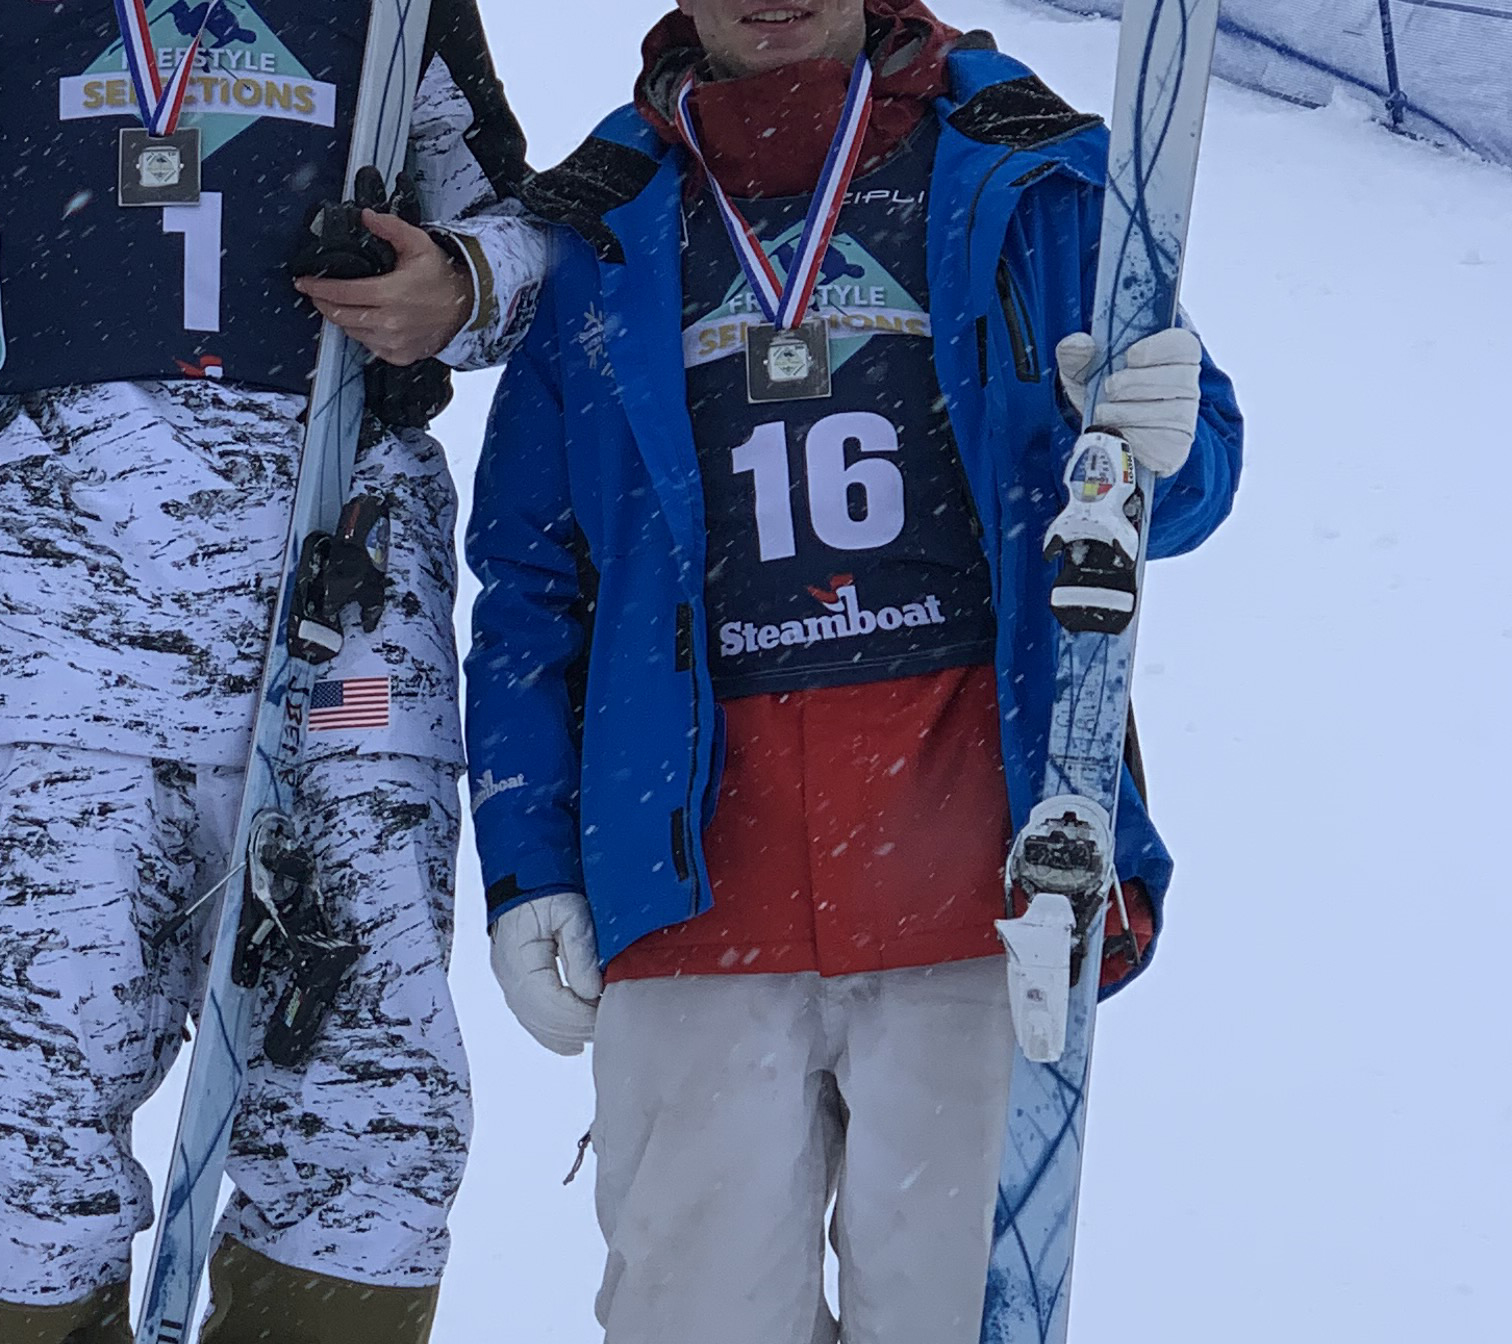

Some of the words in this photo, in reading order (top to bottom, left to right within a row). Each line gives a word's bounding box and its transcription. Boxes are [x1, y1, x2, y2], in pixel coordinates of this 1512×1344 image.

[122, 47, 276, 73] ESTYLE
[83, 76, 317, 113] SETIONS
[843, 190, 925, 204] IPLI
[162, 192, 223, 333] 1
[729, 284, 886, 314] FRTYLE
[698, 312, 927, 357] SEIONS
[731, 411, 906, 563] 16
[718, 583, 946, 658] Steamboat
